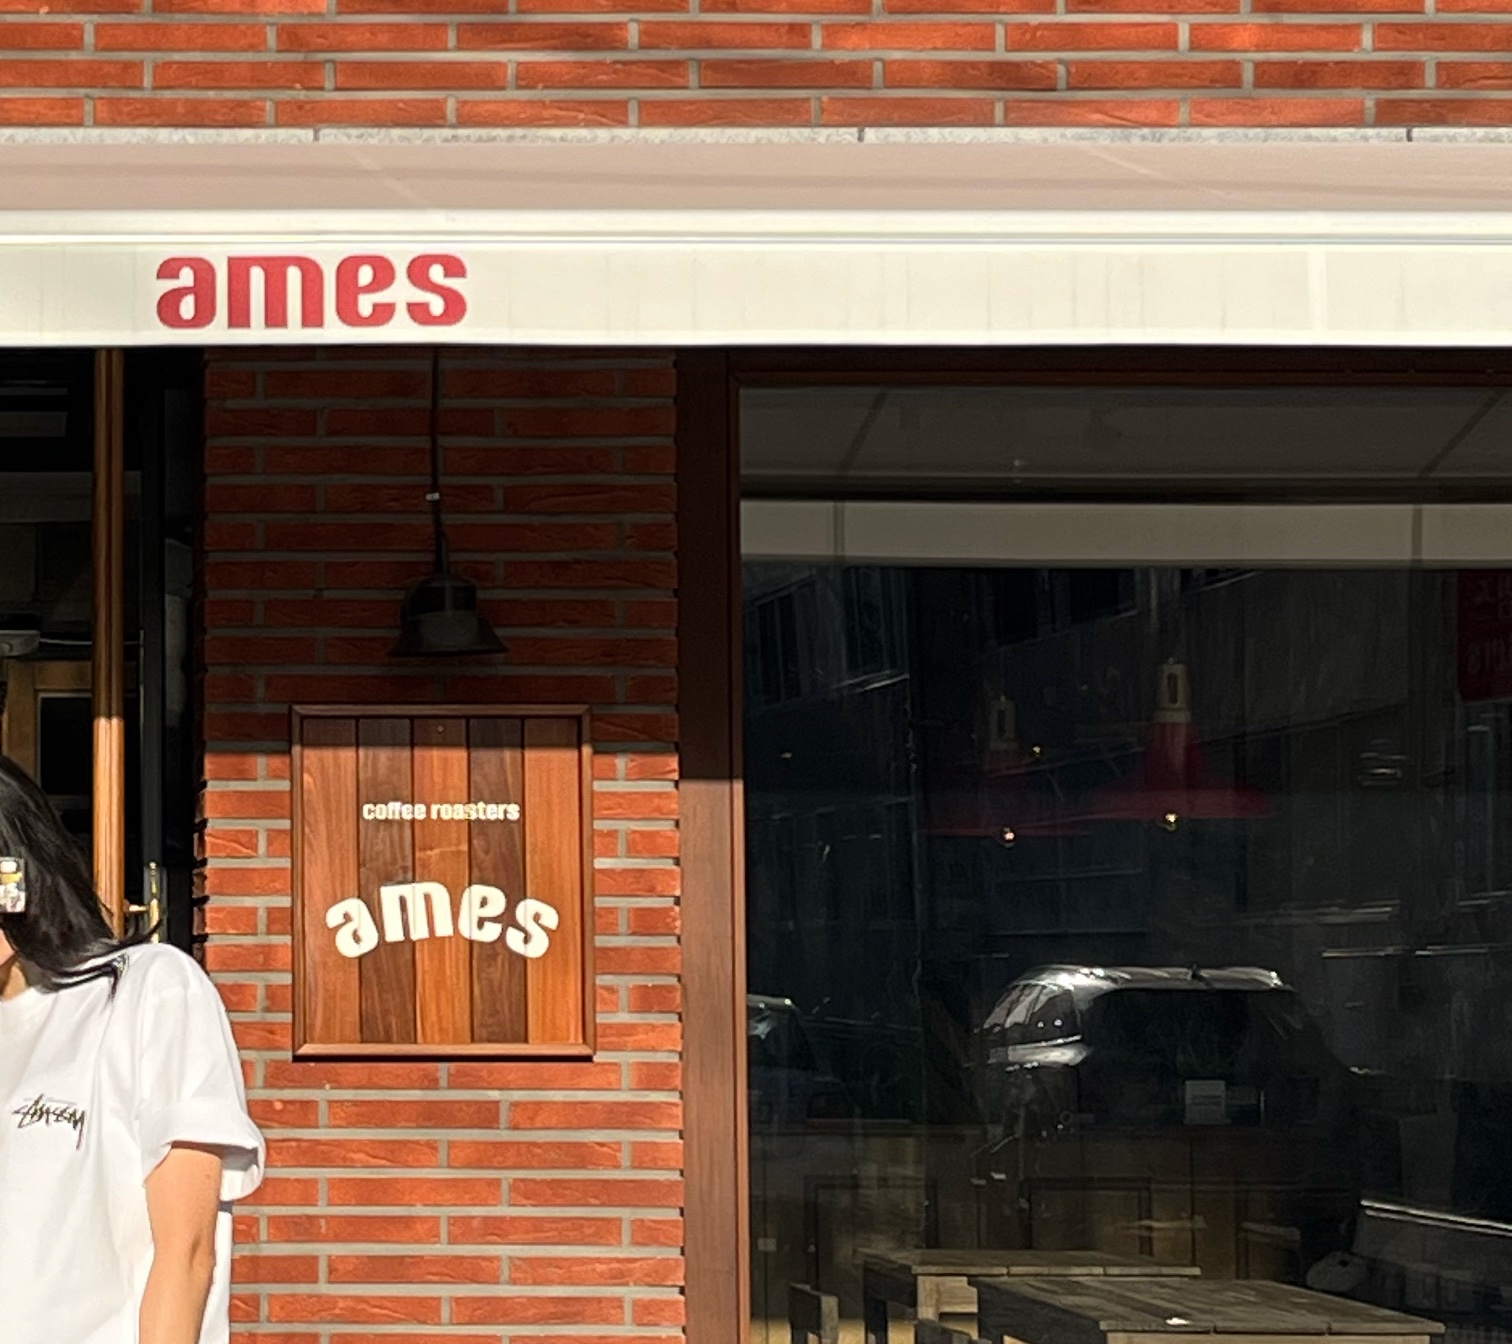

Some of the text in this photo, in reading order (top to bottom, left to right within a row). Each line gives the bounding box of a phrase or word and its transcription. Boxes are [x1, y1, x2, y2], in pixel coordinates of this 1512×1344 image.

[156, 253, 468, 329] ames
[362, 801, 520, 821] coffee roasters
[325, 881, 559, 959] ames
